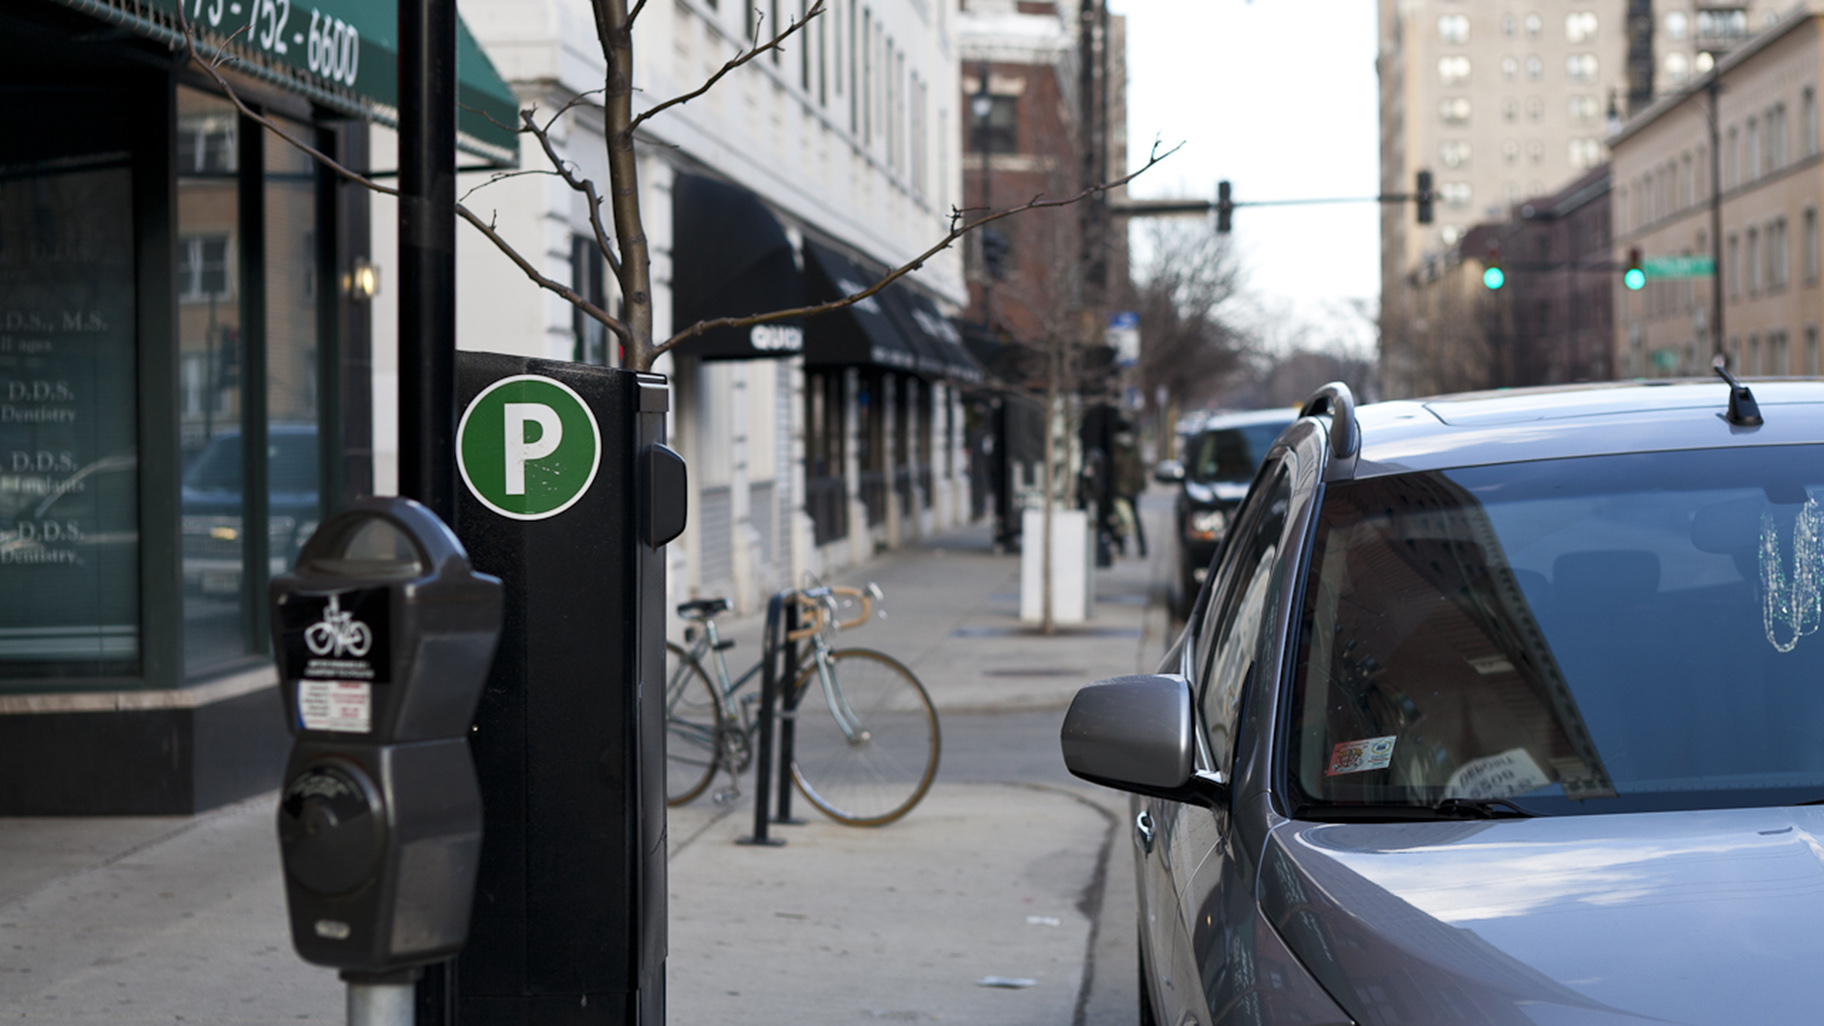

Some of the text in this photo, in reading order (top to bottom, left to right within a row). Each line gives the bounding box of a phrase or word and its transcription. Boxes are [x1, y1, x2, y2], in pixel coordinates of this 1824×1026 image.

[63, 311, 108, 332] M.S.
[8, 380, 75, 402] D.D.S.
[1, 404, 76, 424] Dentistry
[504, 403, 563, 495] P
[12, 450, 79, 472] D.D.S.
[18, 520, 84, 542] D.D.S.
